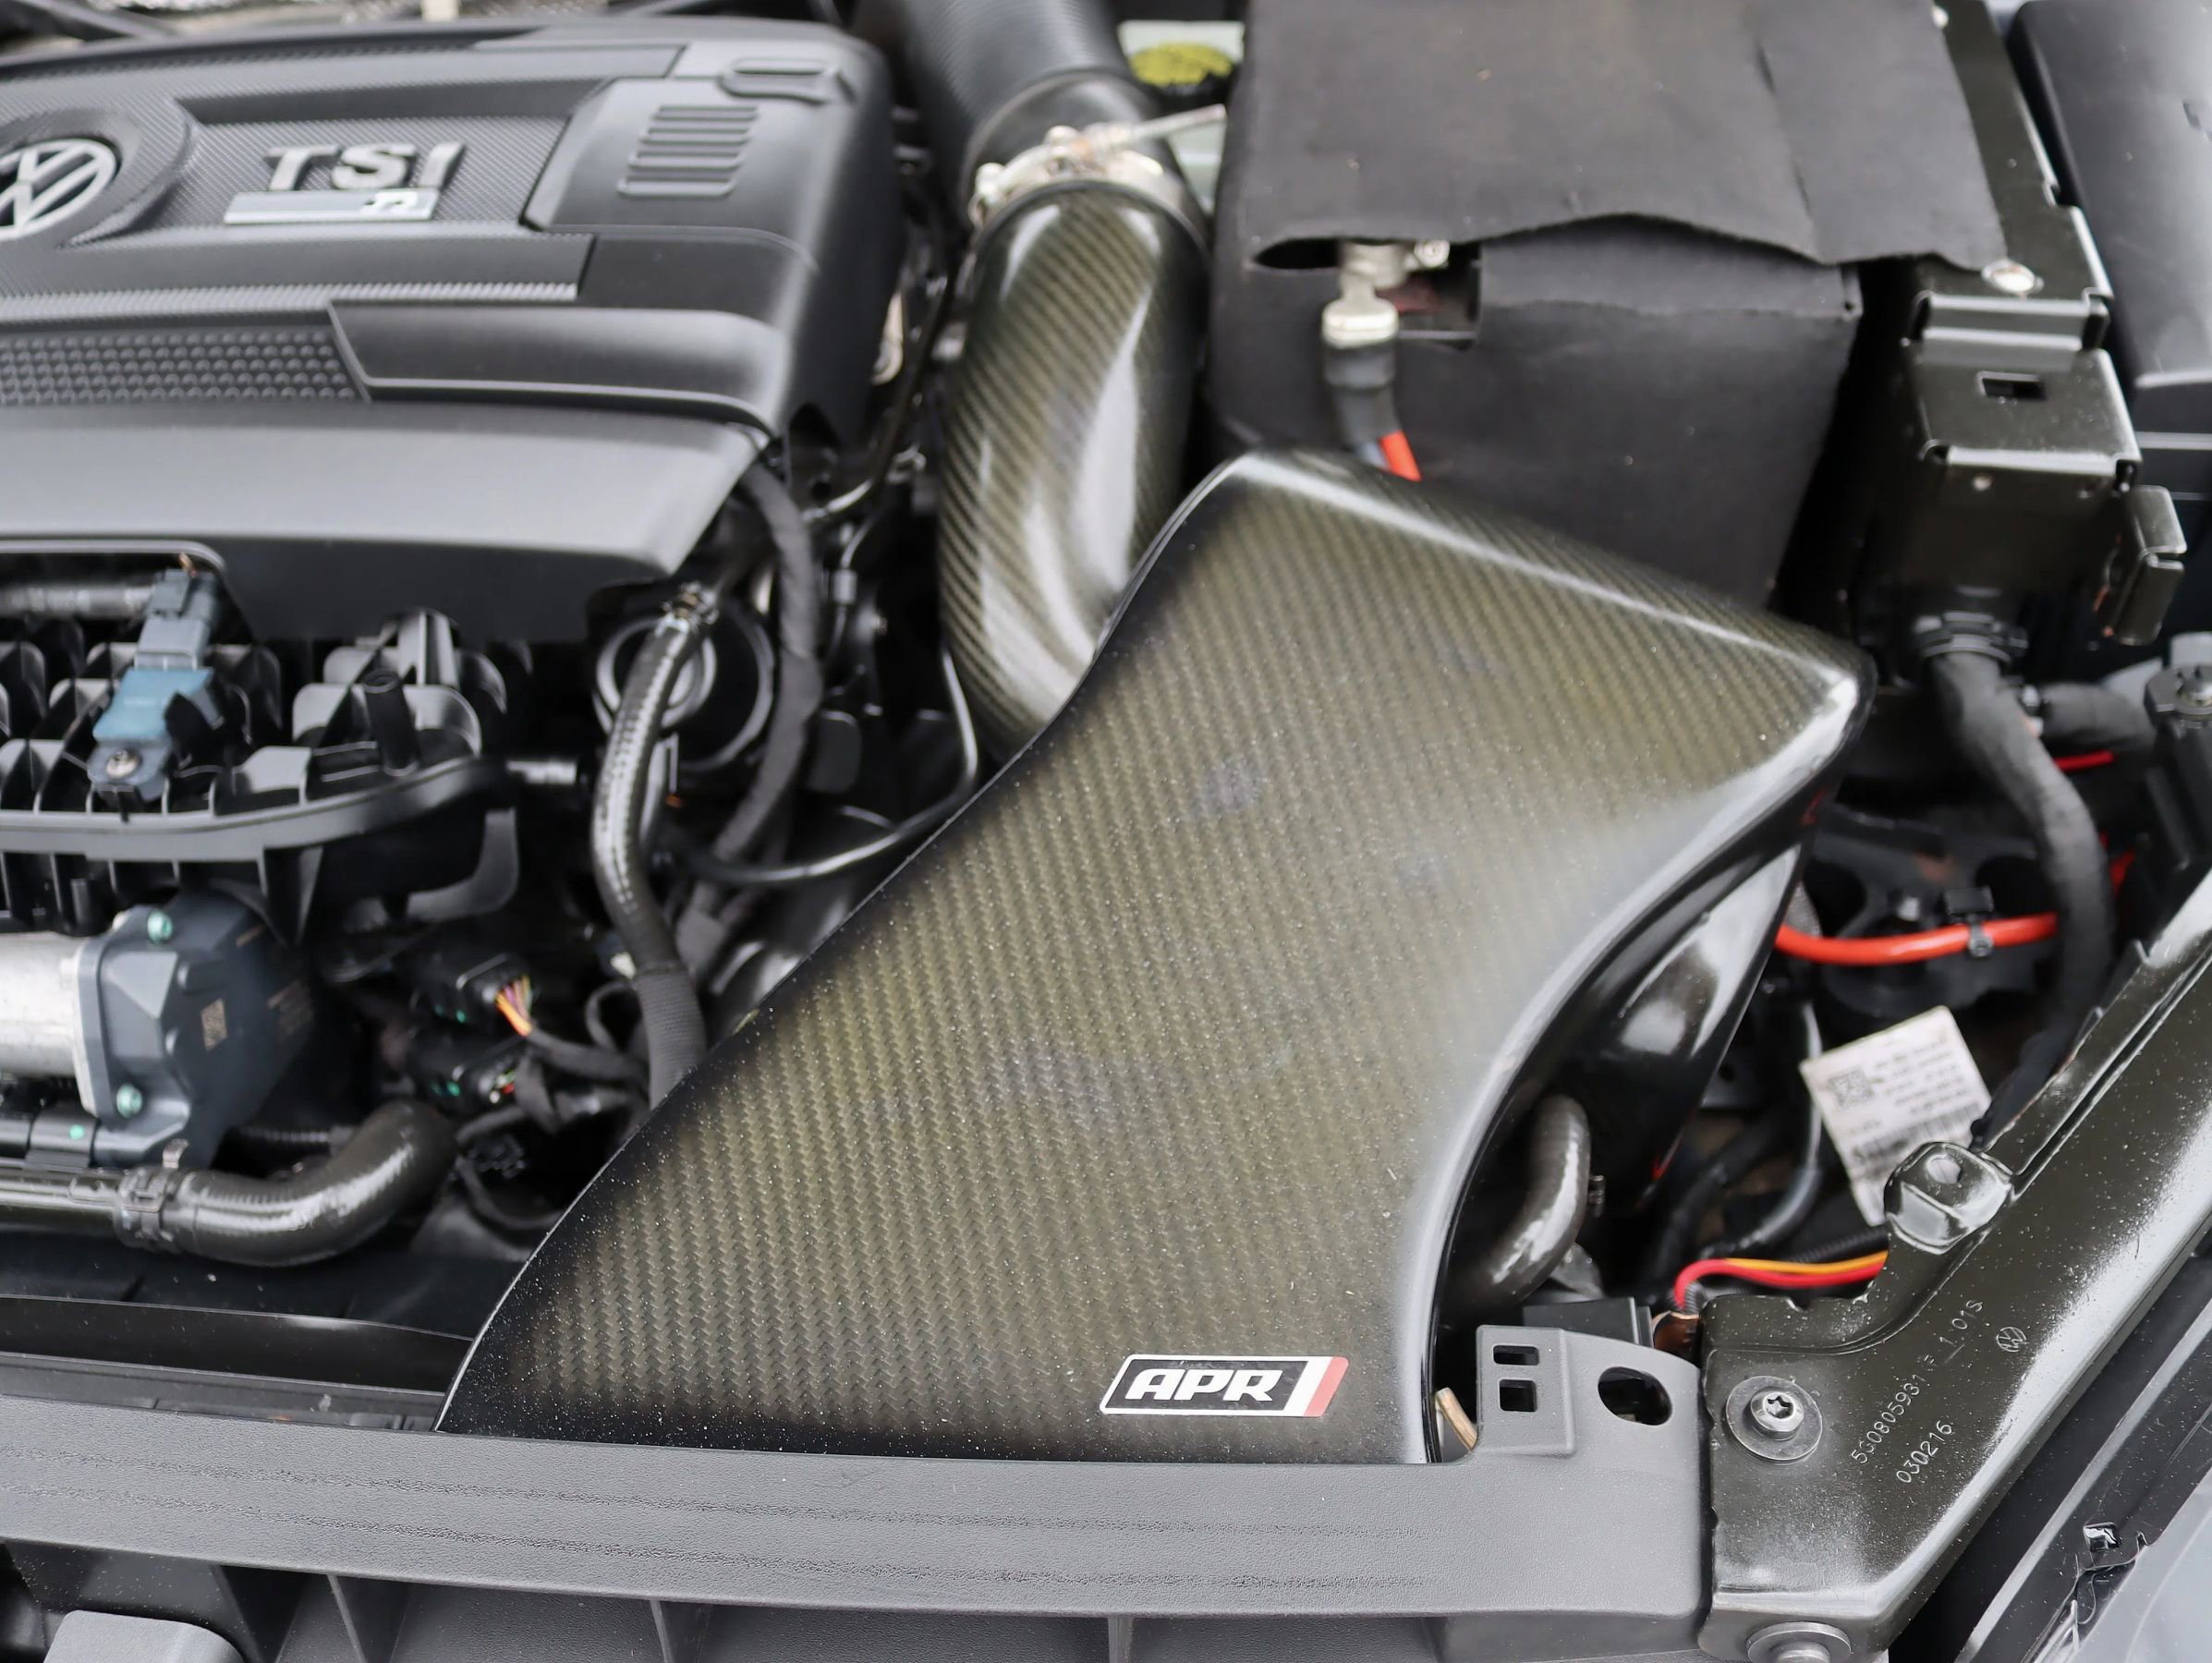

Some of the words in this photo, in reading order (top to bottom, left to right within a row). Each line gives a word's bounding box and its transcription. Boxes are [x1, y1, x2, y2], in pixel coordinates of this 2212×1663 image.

[266, 142, 464, 191] TSI
[1124, 1368, 1283, 1402] APR
[1896, 1420, 1952, 1484] 030216
